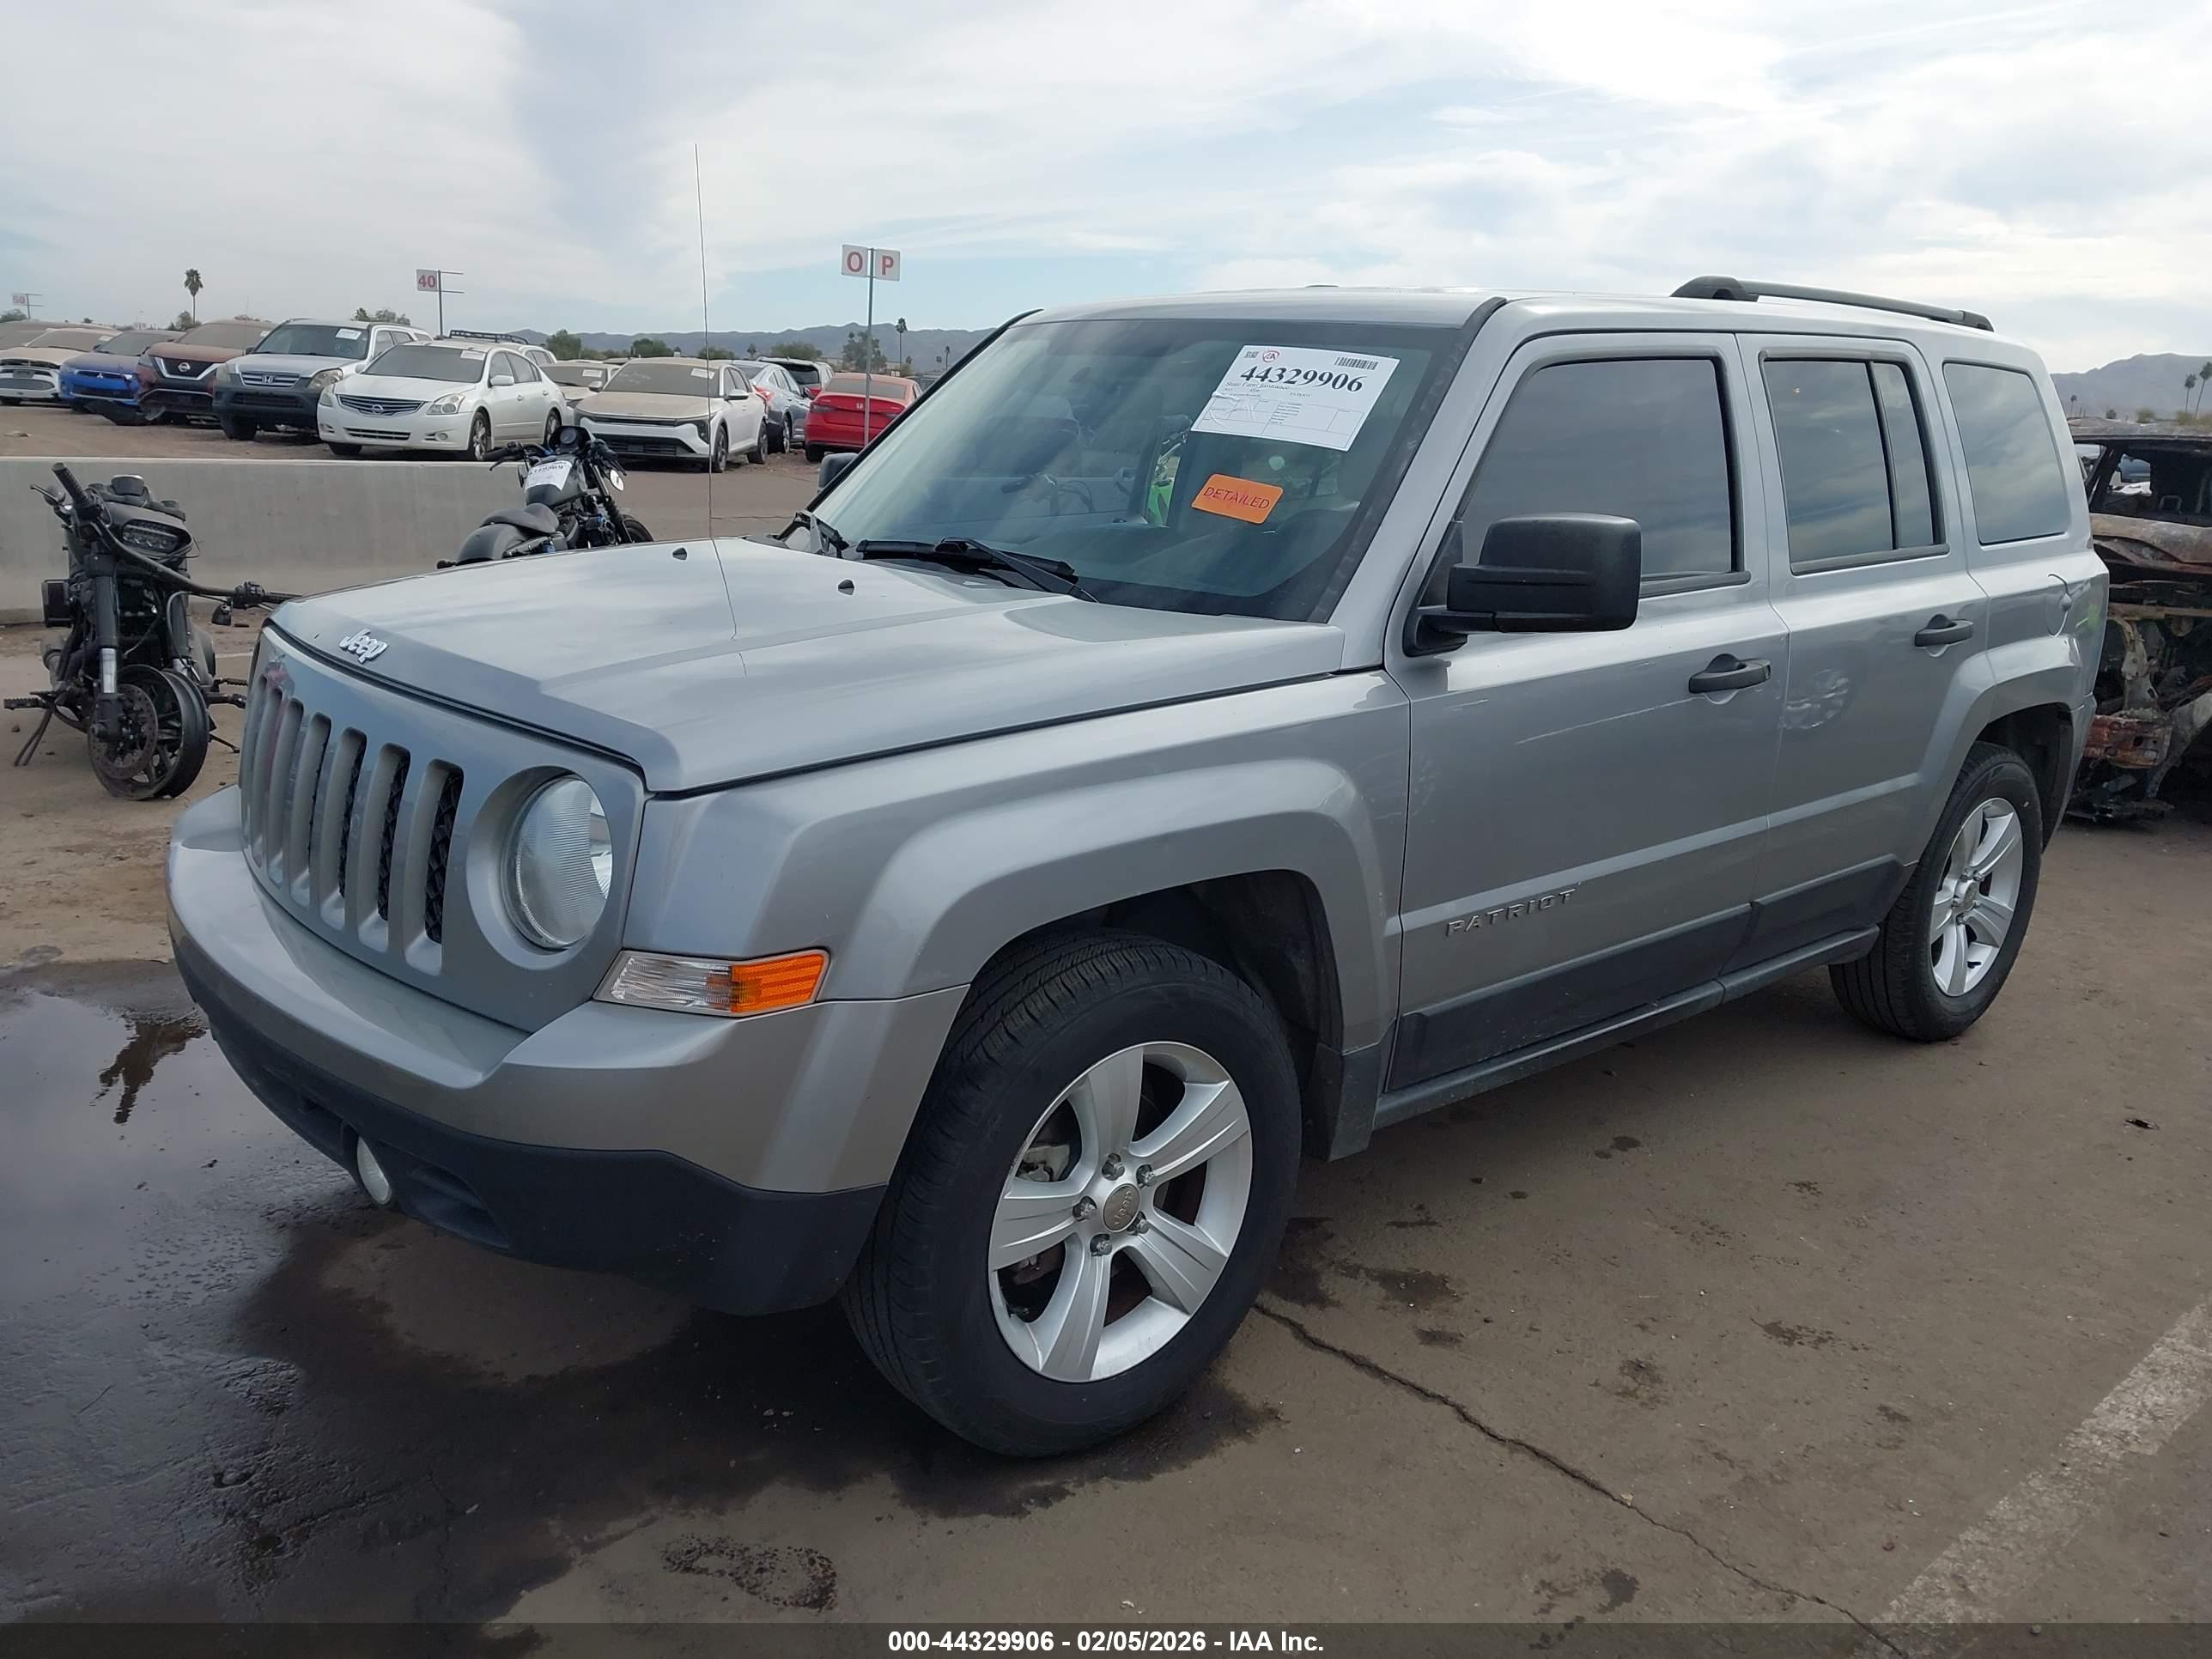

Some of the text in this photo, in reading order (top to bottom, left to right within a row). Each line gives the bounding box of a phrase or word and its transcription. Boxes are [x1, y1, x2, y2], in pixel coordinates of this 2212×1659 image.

[847, 251, 863, 272] O
[881, 255, 894, 276] P
[418, 274, 436, 288] 40
[1240, 365, 1367, 393] 44329906
[1203, 486, 1270, 509] DETAILED
[338, 628, 388, 664] Jeep
[1445, 888, 1577, 937] PATRIOT
